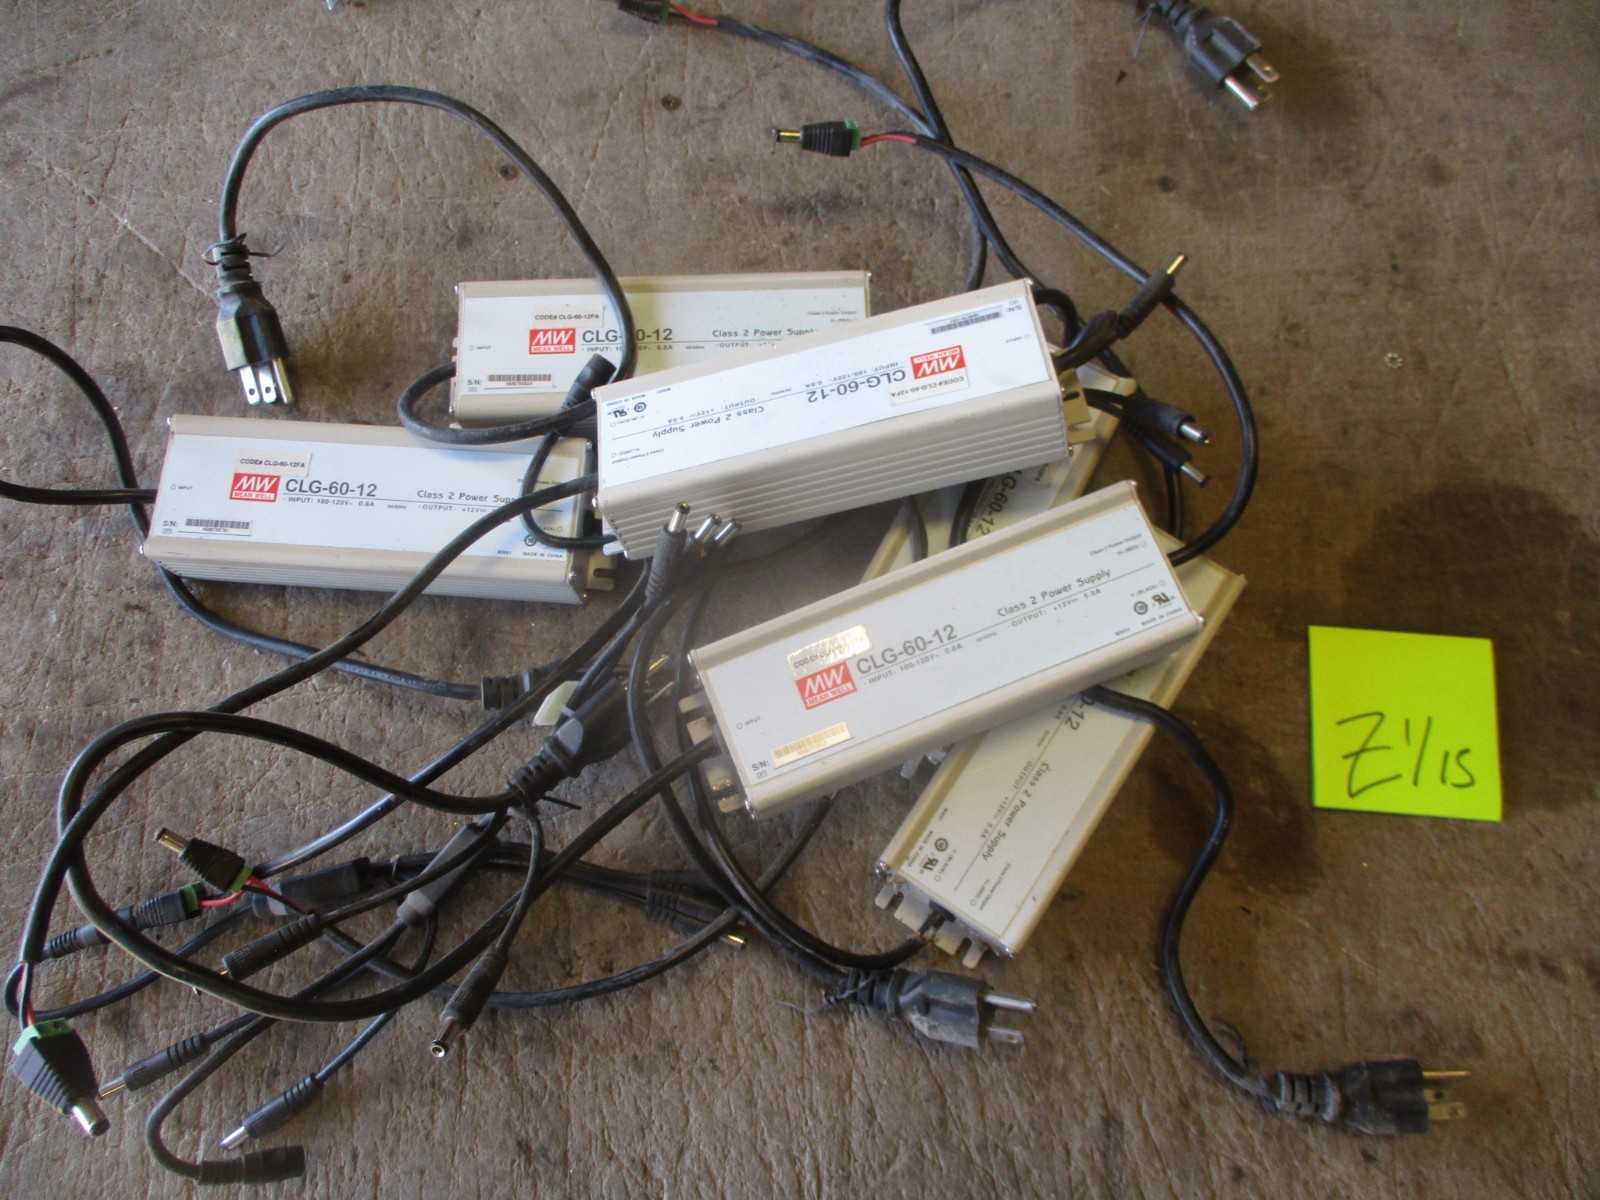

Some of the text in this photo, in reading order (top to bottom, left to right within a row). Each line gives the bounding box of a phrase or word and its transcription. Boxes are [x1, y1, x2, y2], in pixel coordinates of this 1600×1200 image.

[532, 330, 573, 345] MW
[582, 328, 673, 343] CLG-0-12
[712, 329, 738, 337] Class
[743, 329, 749, 337] 2
[754, 329, 782, 337] Power
[807, 370, 906, 403] CLG-60-12
[737, 405, 764, 417] Class
[691, 416, 720, 429] Power
[652, 424, 685, 438] Supply
[235, 476, 277, 490] MW
[285, 479, 377, 497] CLG-60-12
[417, 490, 444, 499] Class
[459, 493, 488, 502] Power
[997, 568, 1111, 617] Class 2 Power Supply
[856, 625, 957, 674] CLG-60-12
[805, 665, 844, 698] MW
[808, 685, 851, 706] MEAN WELL
[1029, 762, 1050, 787] Class
[1023, 789, 1032, 798] 2
[1005, 799, 1026, 827] Power
[982, 830, 1007, 861] Supply
